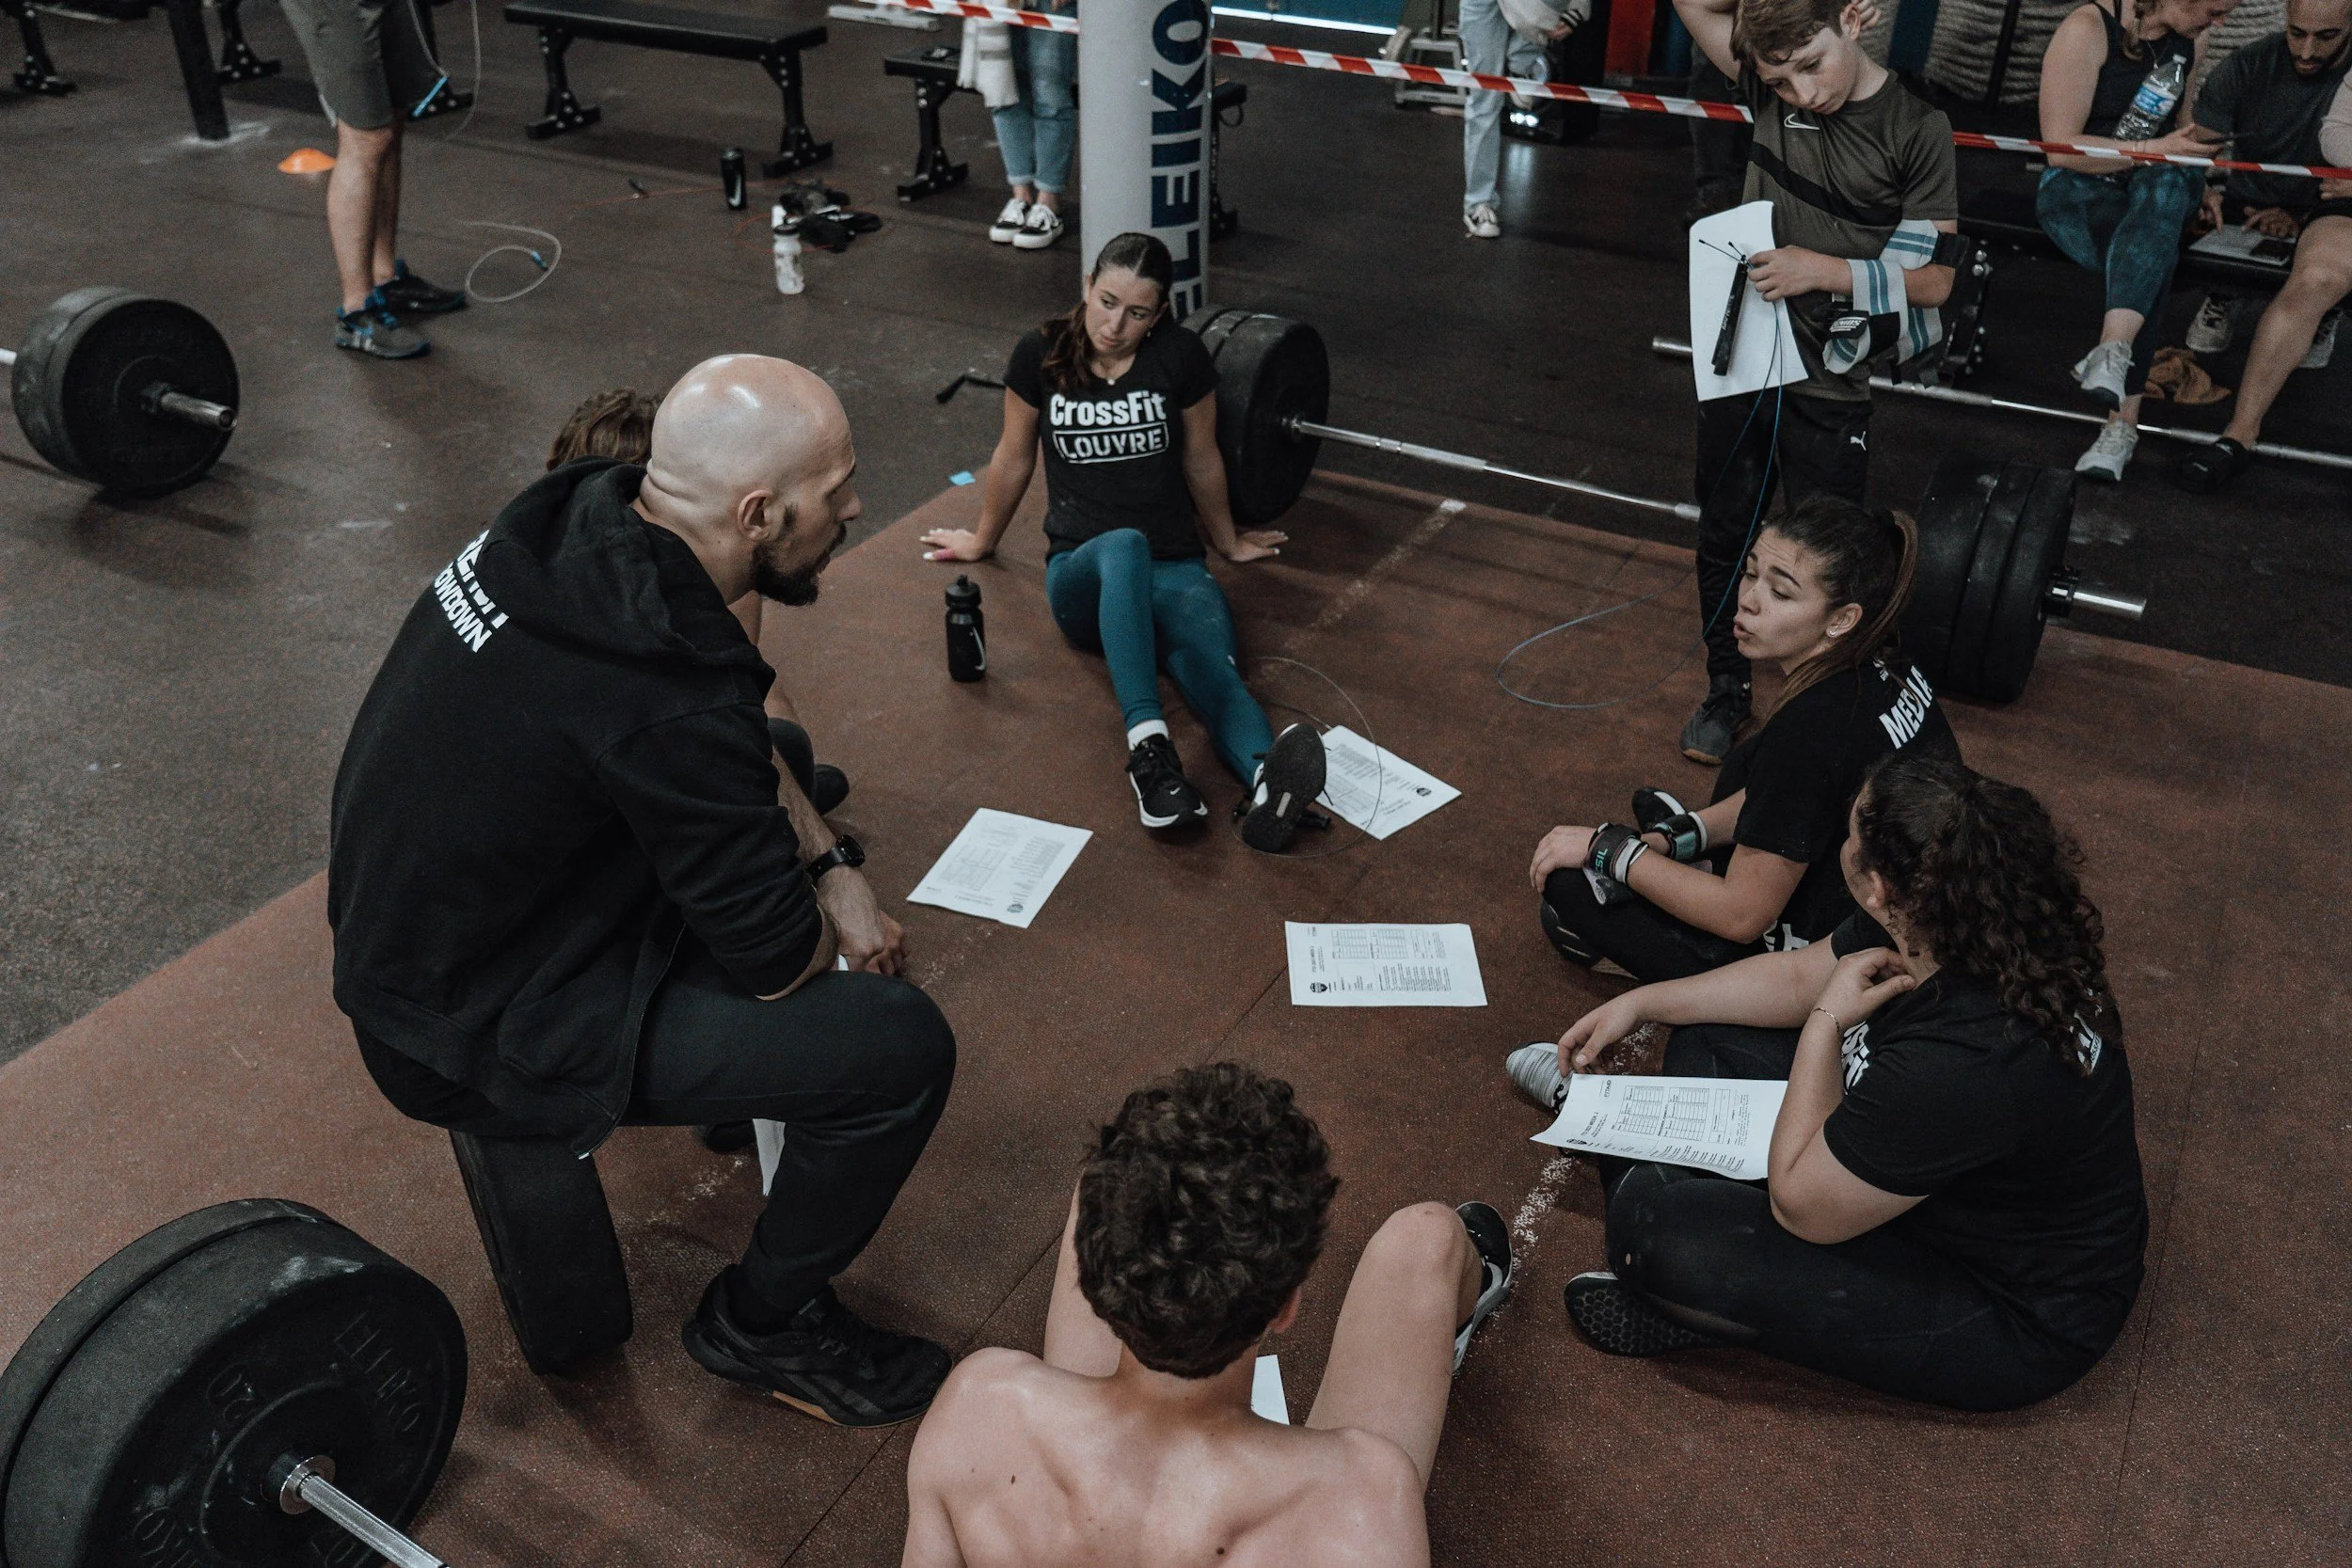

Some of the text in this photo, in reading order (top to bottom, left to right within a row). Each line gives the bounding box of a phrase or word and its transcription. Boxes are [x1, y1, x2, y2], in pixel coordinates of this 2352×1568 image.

[1049, 389, 1168, 427] CrossFit
[1057, 428, 1164, 459] LOUVRE
[434, 562, 493, 653] OWDOWN
